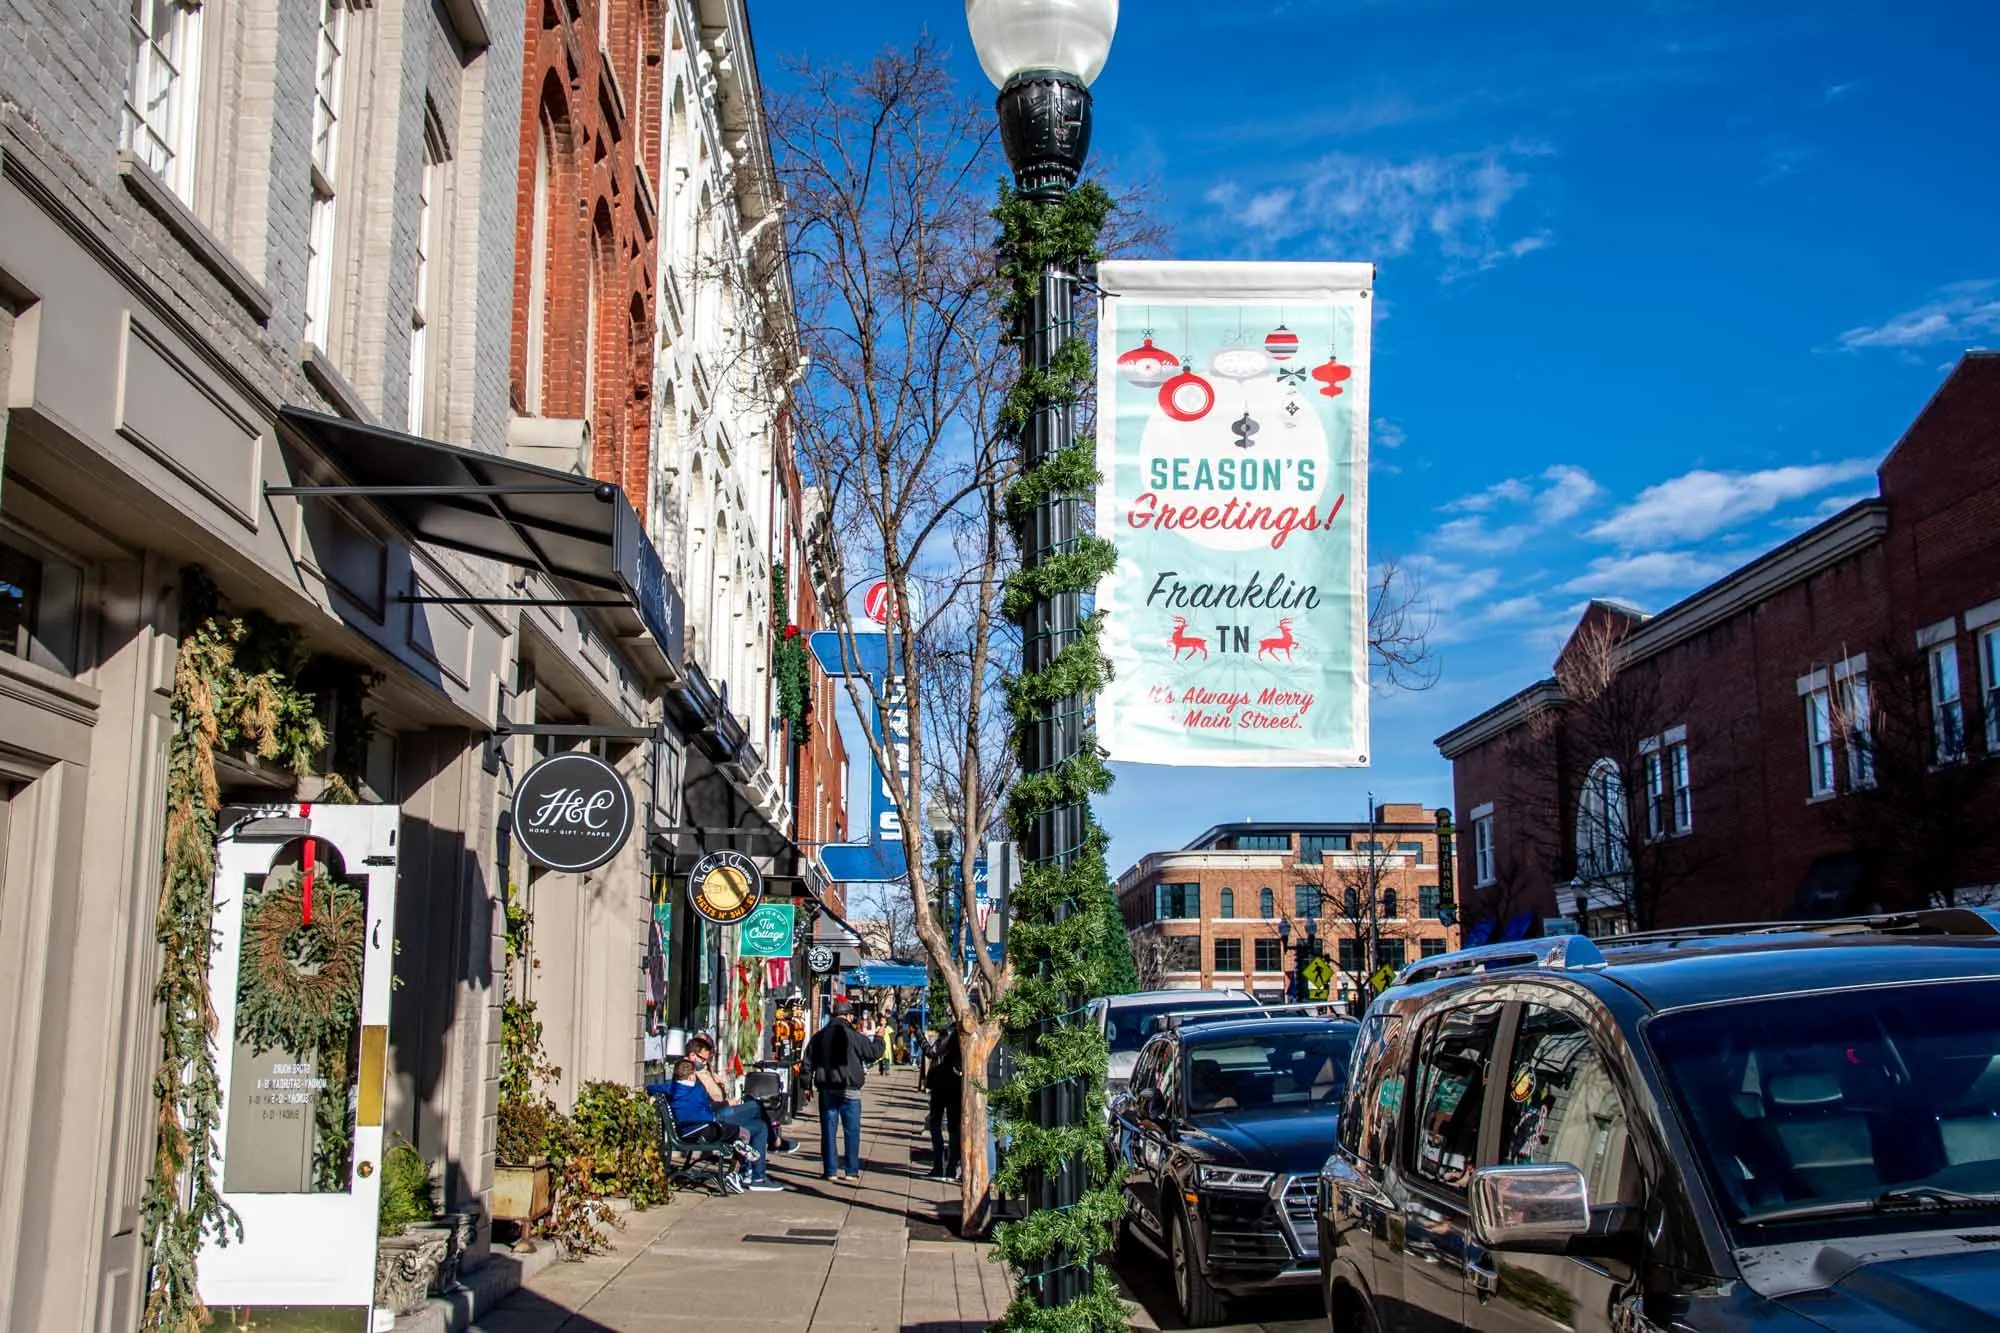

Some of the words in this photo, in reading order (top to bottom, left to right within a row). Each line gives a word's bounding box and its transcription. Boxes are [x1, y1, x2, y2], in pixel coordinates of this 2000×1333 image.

[1150, 457, 1316, 492] SEASON'S
[1127, 492, 1345, 550] Greetings!
[1146, 570, 1321, 609] Franklin
[1216, 625, 1250, 653] TN
[1182, 687, 1250, 713] Always
[1256, 687, 1314, 715] Merry
[1183, 710, 1232, 729] Main
[1239, 710, 1303, 729] Street.
[528, 787, 615, 829] H&C
[695, 894, 717, 918] MELTS
[729, 894, 757, 919] SHAES
[750, 927, 785, 942] Cottage
[760, 918, 775, 930] Tin
